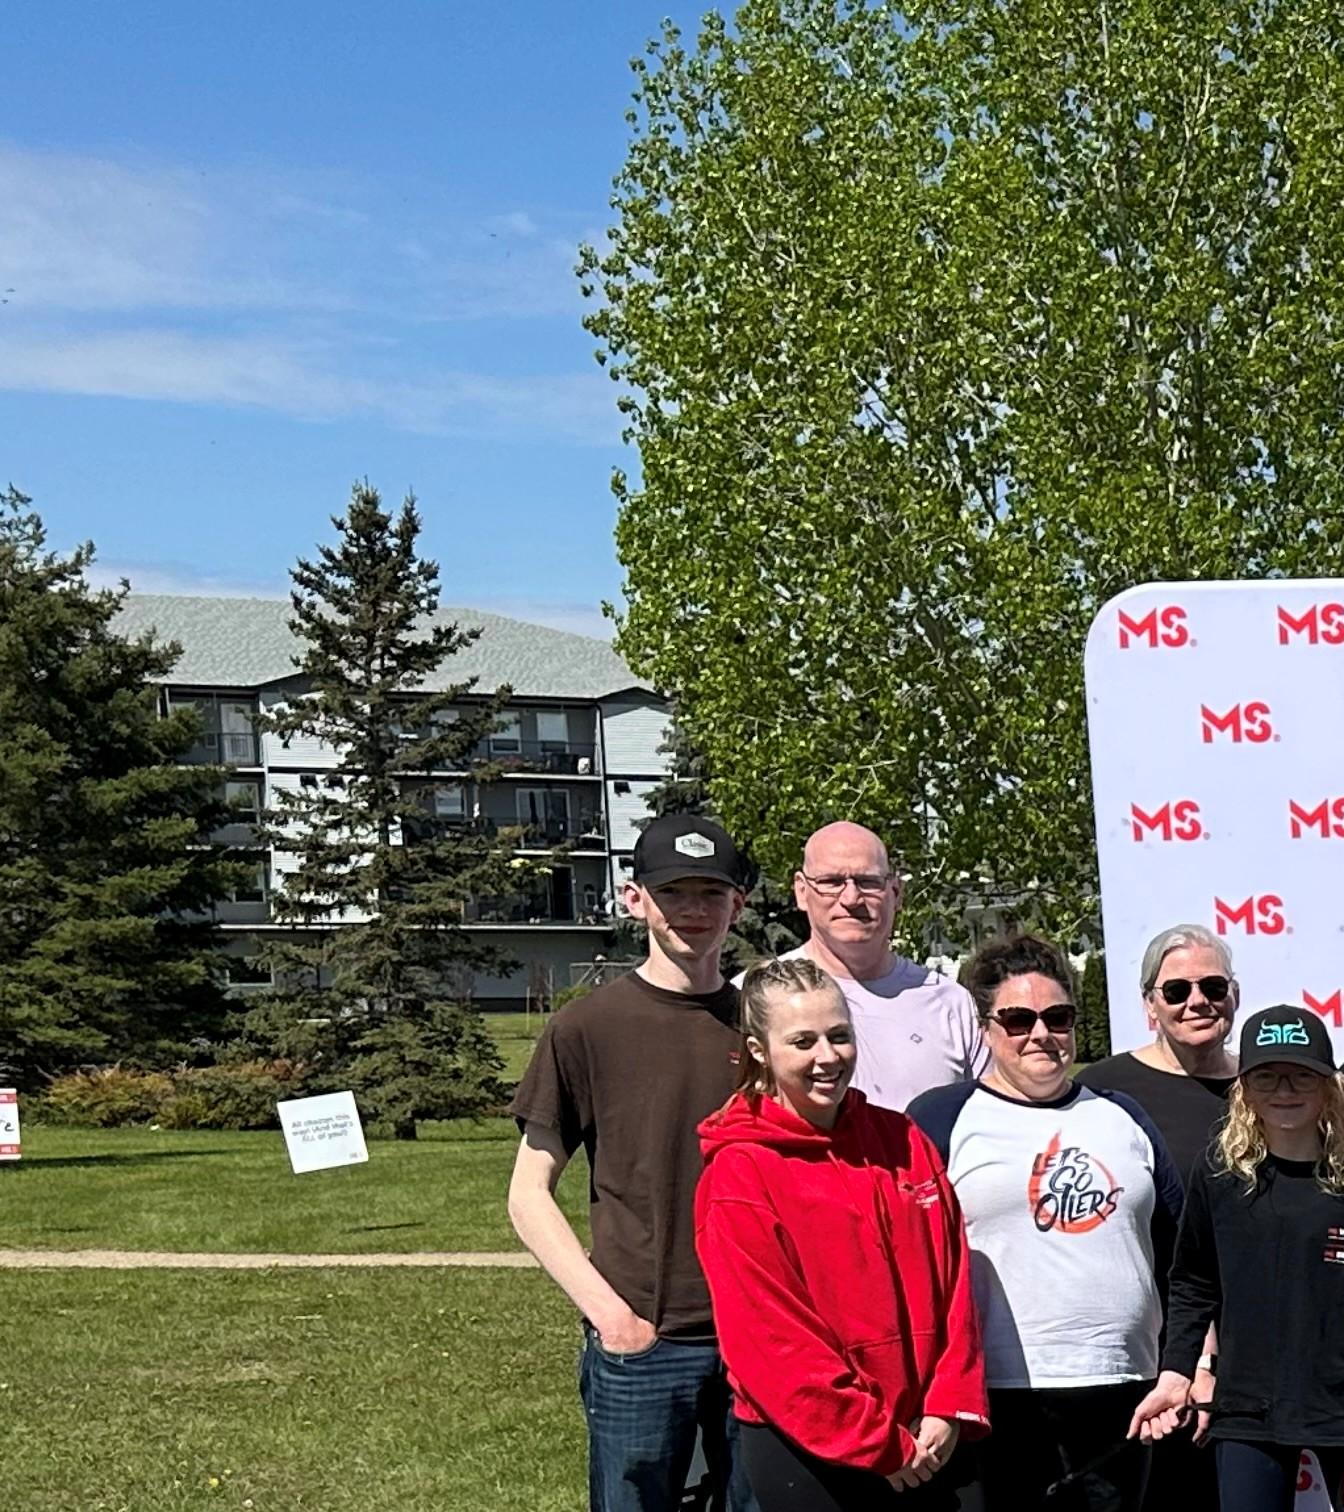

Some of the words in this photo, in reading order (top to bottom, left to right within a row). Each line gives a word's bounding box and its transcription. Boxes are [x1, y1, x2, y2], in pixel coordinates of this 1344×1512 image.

[1119, 606, 1188, 648] MS
[1202, 702, 1272, 743] MS
[1131, 801, 1201, 841] MS
[1214, 895, 1285, 935] MS
[1048, 1165, 1093, 1194] GO
[1034, 1186, 1125, 1232] OILERS
